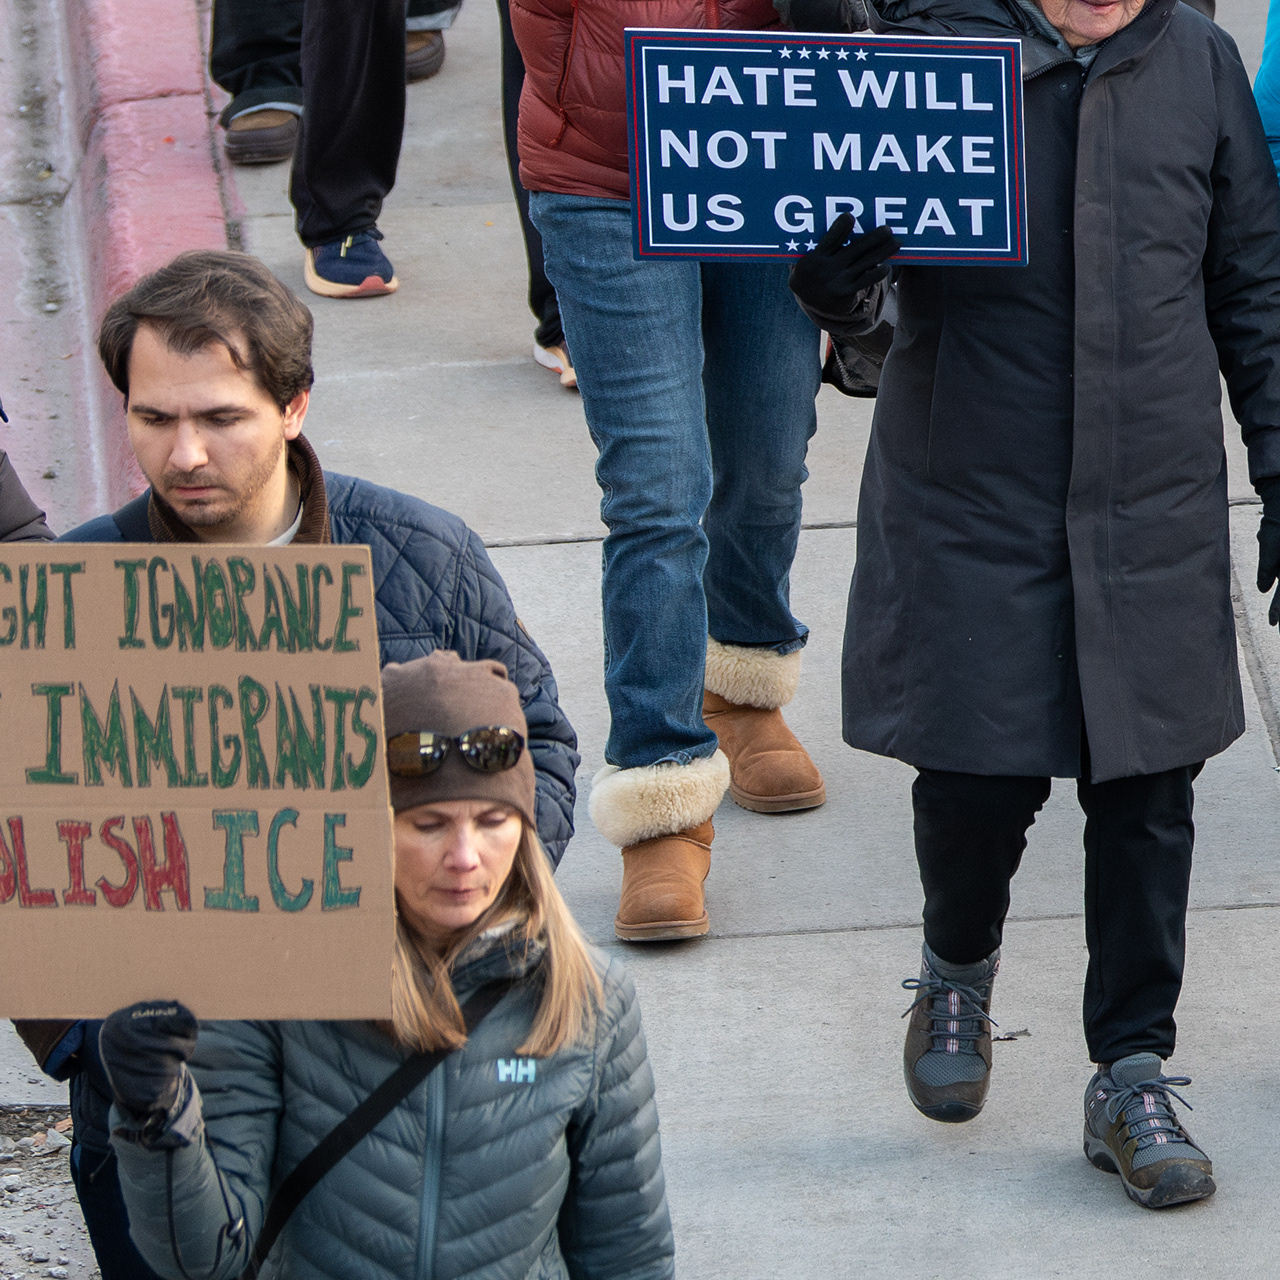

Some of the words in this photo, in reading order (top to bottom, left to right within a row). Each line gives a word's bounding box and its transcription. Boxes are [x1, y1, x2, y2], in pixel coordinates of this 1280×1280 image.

[657, 64, 817, 108] HATE
[837, 68, 994, 112] WILL
[660, 128, 788, 170] NOT
[813, 131, 995, 174] MAKE
[661, 192, 746, 232] US
[773, 193, 995, 237] GREAT
[113, 556, 367, 654] IGNORANCE
[25, 675, 378, 792] IMMIGRANTS
[203, 807, 363, 913] ICE
[497, 1057, 536, 1083] HH
